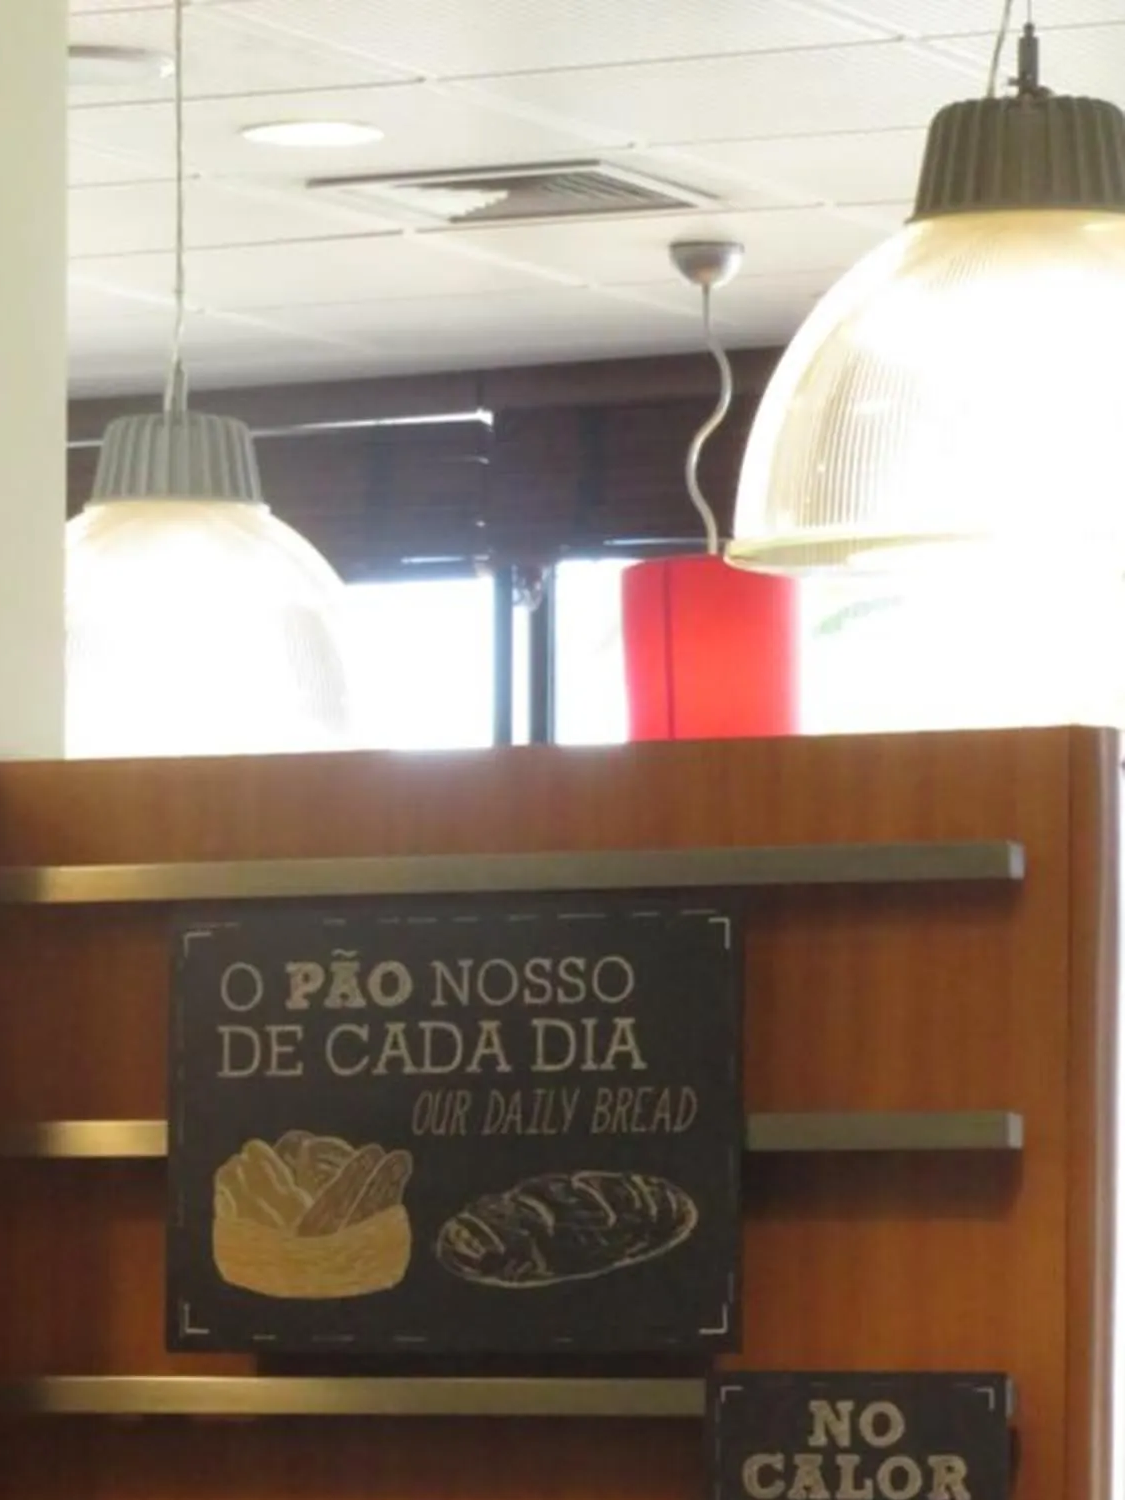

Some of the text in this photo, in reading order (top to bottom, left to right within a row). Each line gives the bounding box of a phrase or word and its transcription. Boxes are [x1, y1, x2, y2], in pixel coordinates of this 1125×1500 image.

[220, 948, 636, 1012] O PÃO NOSSO
[216, 1016, 648, 1078] DE CADA DIA
[411, 1086, 699, 1137] OUR DAILY BREAD
[807, 1399, 906, 1448] NO
